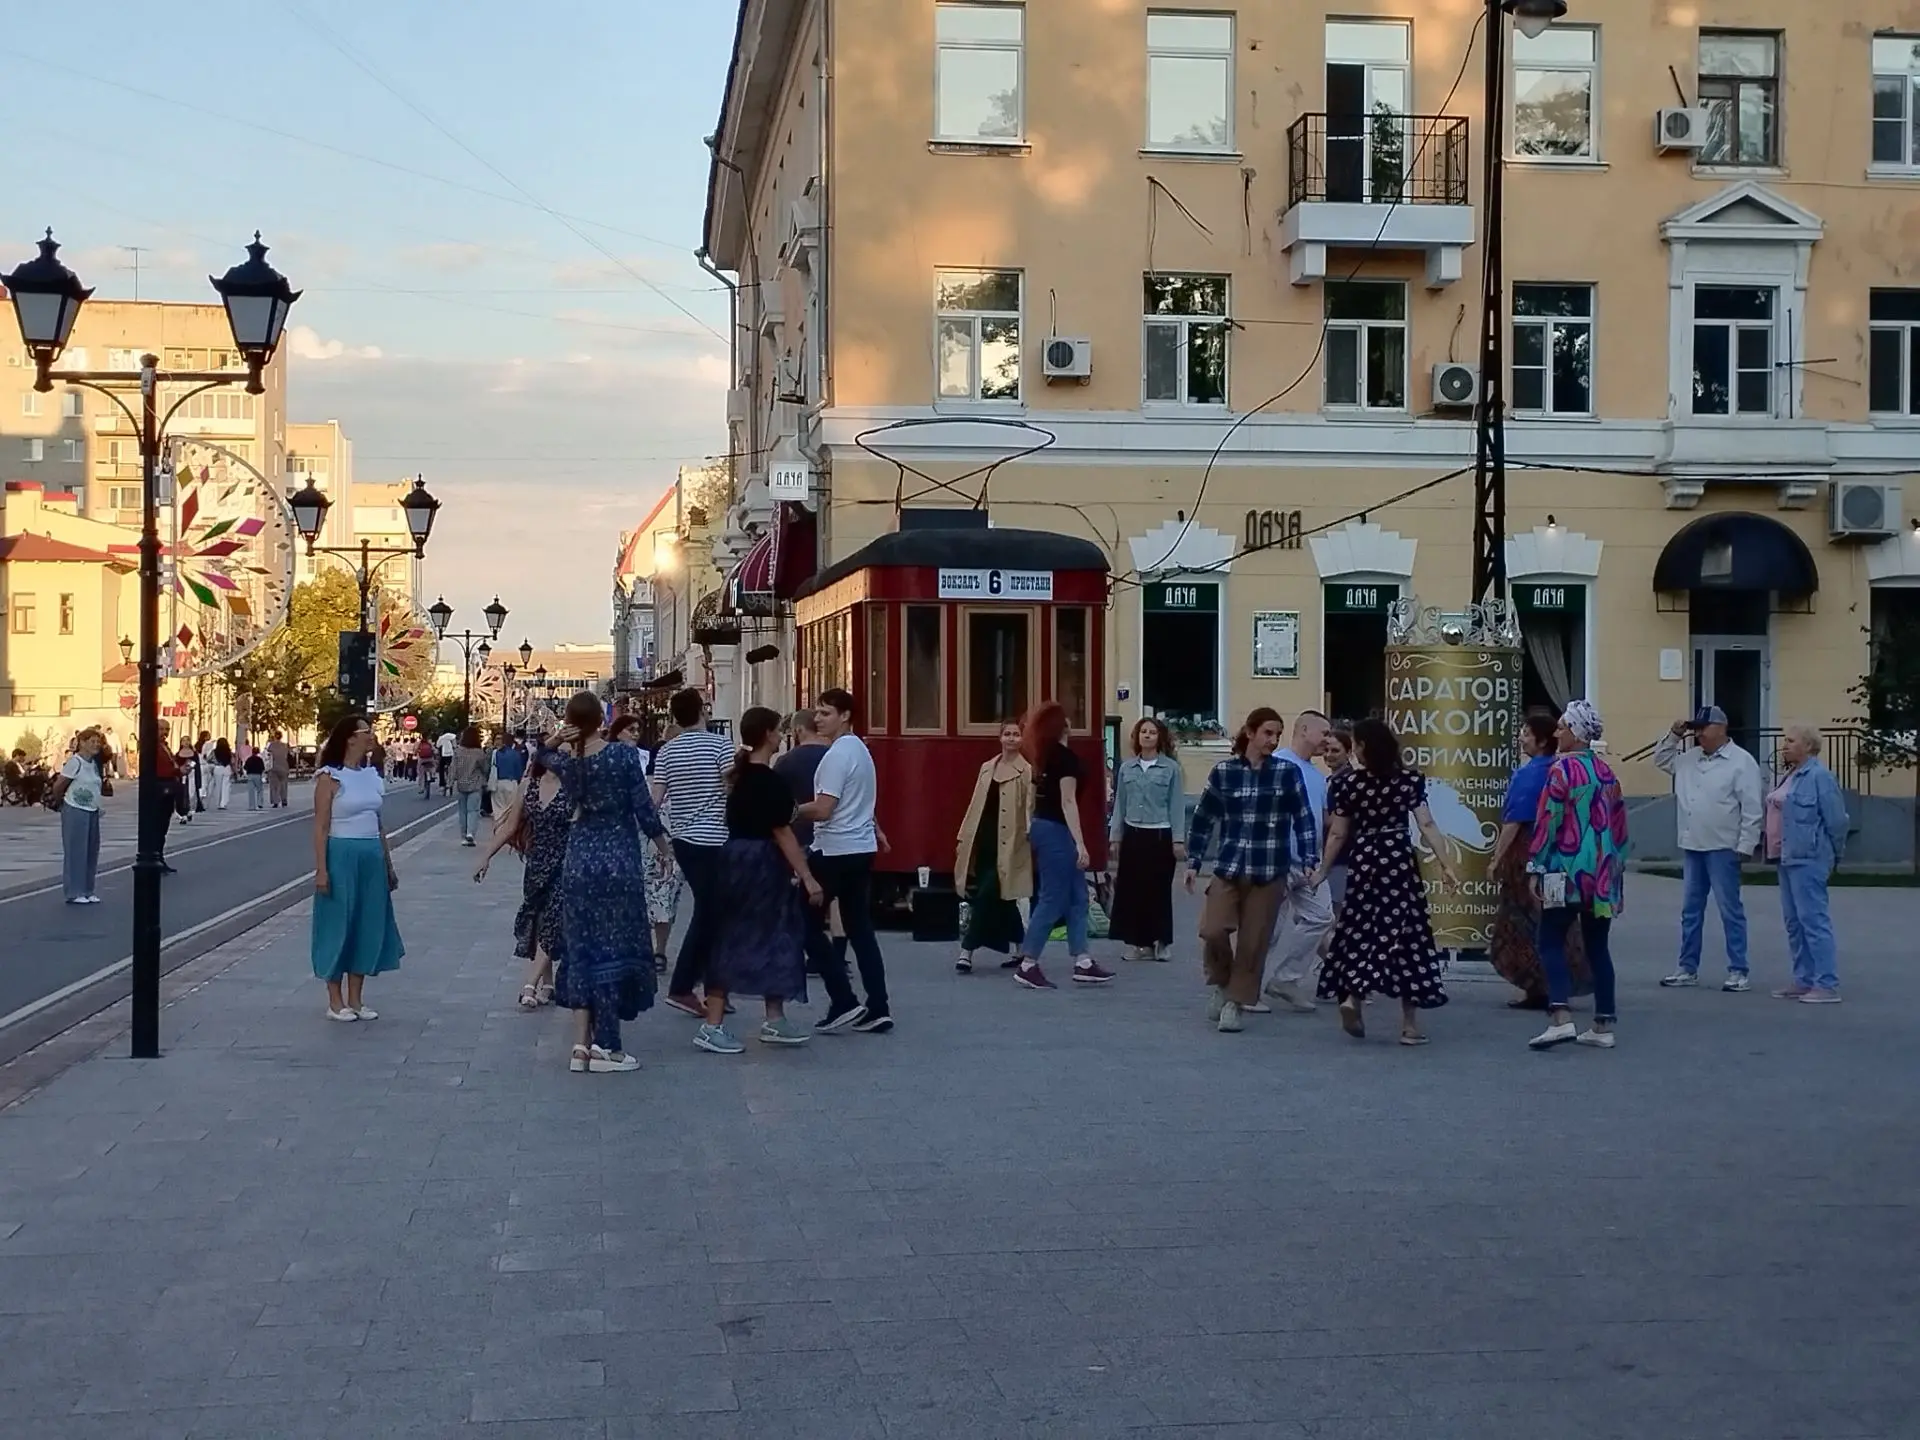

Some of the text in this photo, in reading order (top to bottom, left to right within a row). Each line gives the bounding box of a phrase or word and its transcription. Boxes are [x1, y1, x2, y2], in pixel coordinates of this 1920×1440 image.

[776, 471, 803, 486] ДАЧА
[1243, 509, 1302, 549] ДАЧА
[989, 570, 1002, 594] 6
[1165, 587, 1196, 604] ДАЧА
[1345, 588, 1377, 605] ДАЧА
[1533, 588, 1564, 605] ДАЧА
[1389, 677, 1509, 702] САРАТОВ
[1388, 702, 1509, 736] КАКОЙ?
